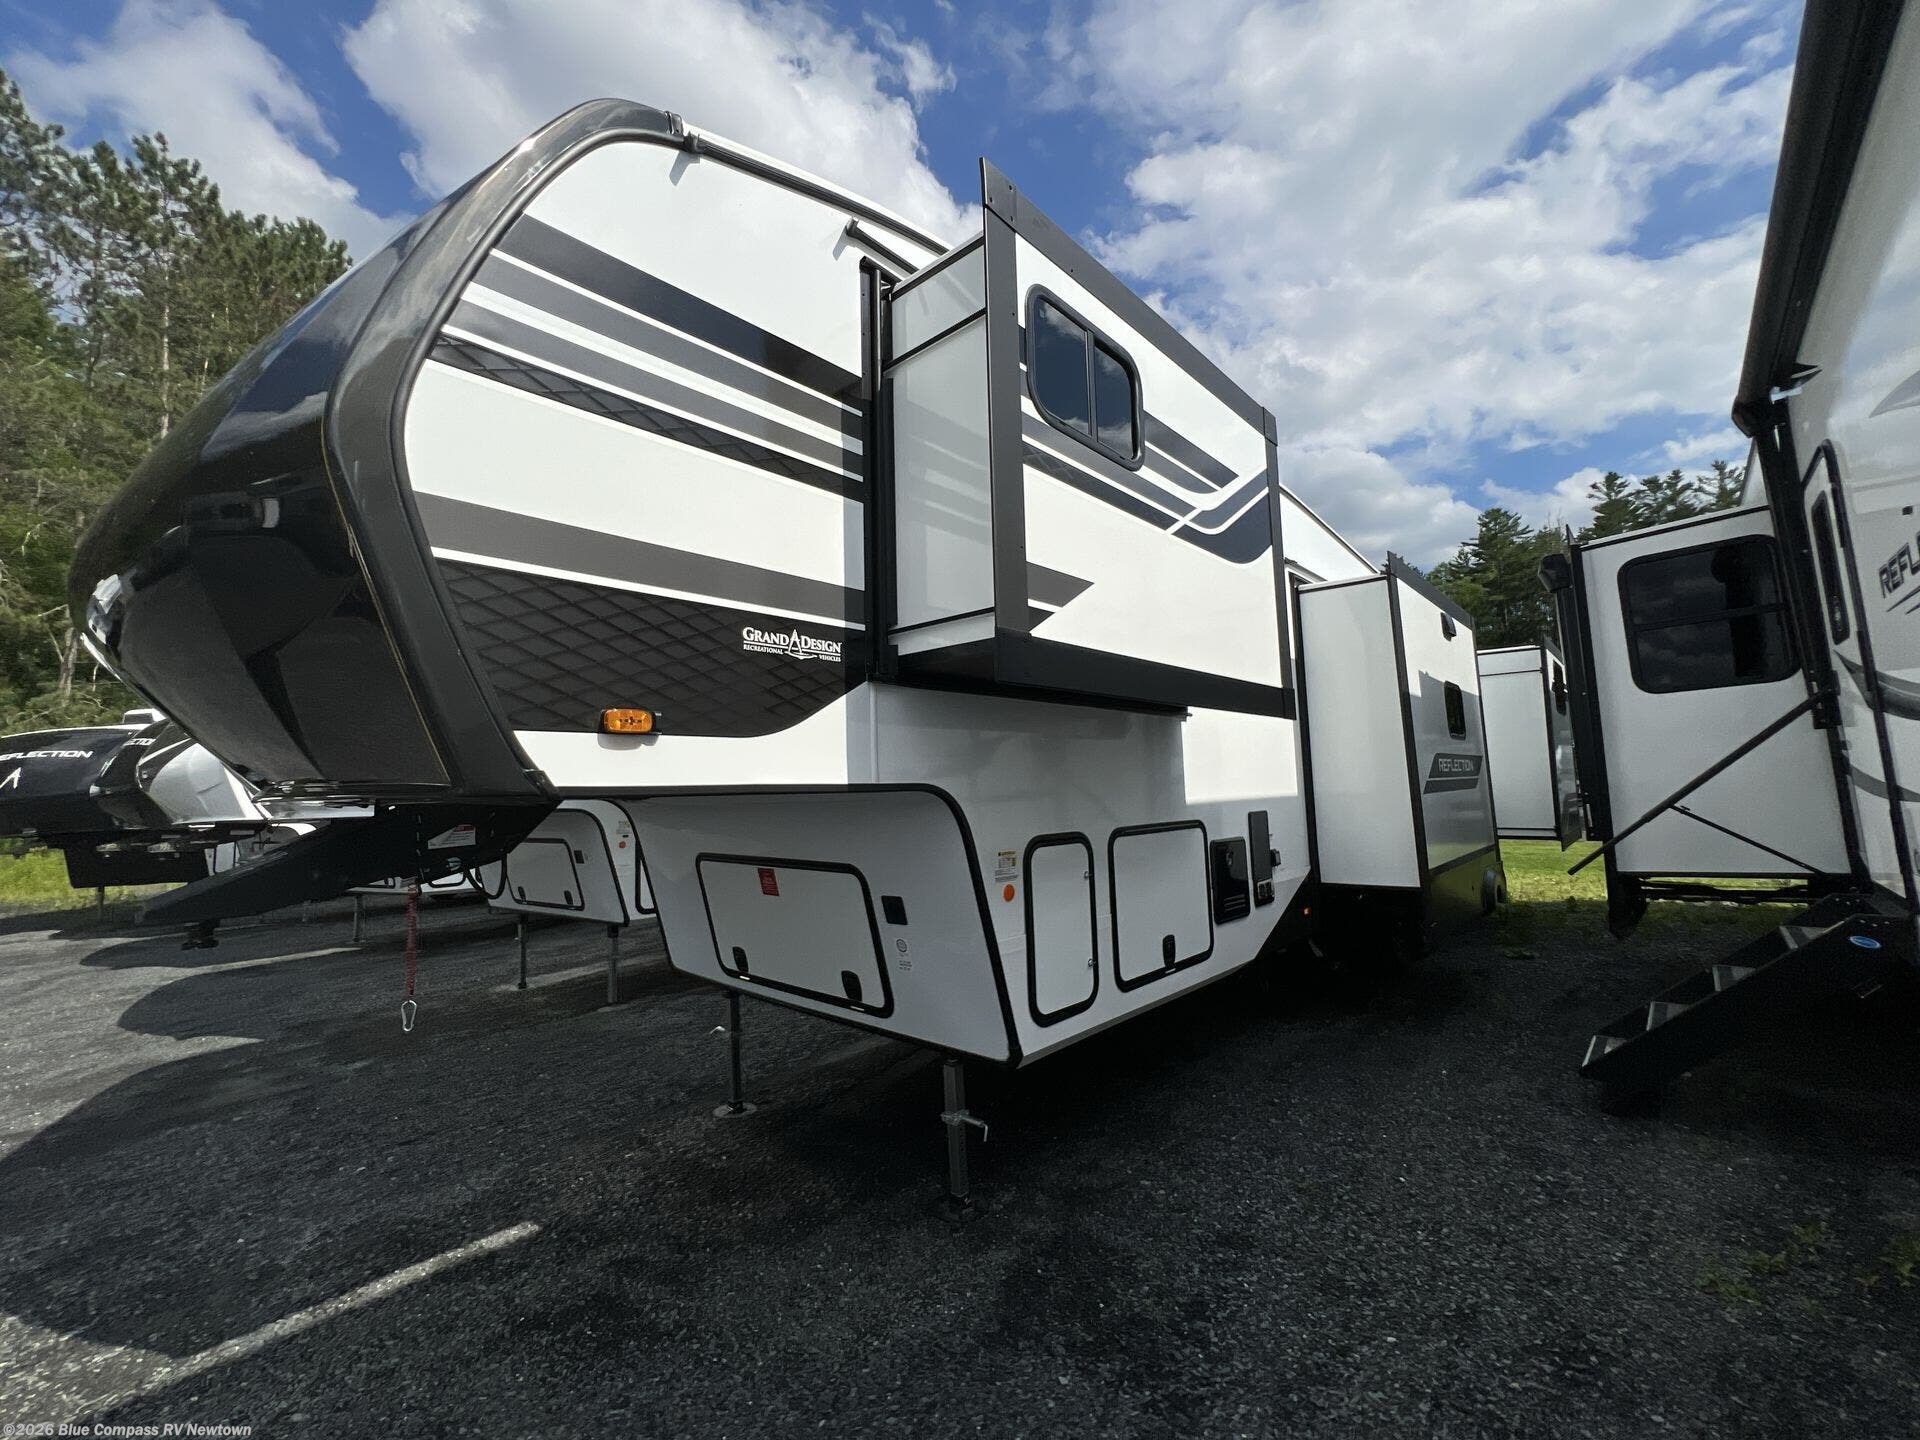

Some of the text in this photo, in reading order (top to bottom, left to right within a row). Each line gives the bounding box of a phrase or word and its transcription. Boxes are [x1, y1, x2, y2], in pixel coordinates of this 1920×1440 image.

[742, 627, 842, 653] GRAND DESIGN
[743, 644, 783, 655] RECREATIONAL
[0, 750, 93, 761] EFLECTION
[1438, 758, 1474, 771] REFLECTION
